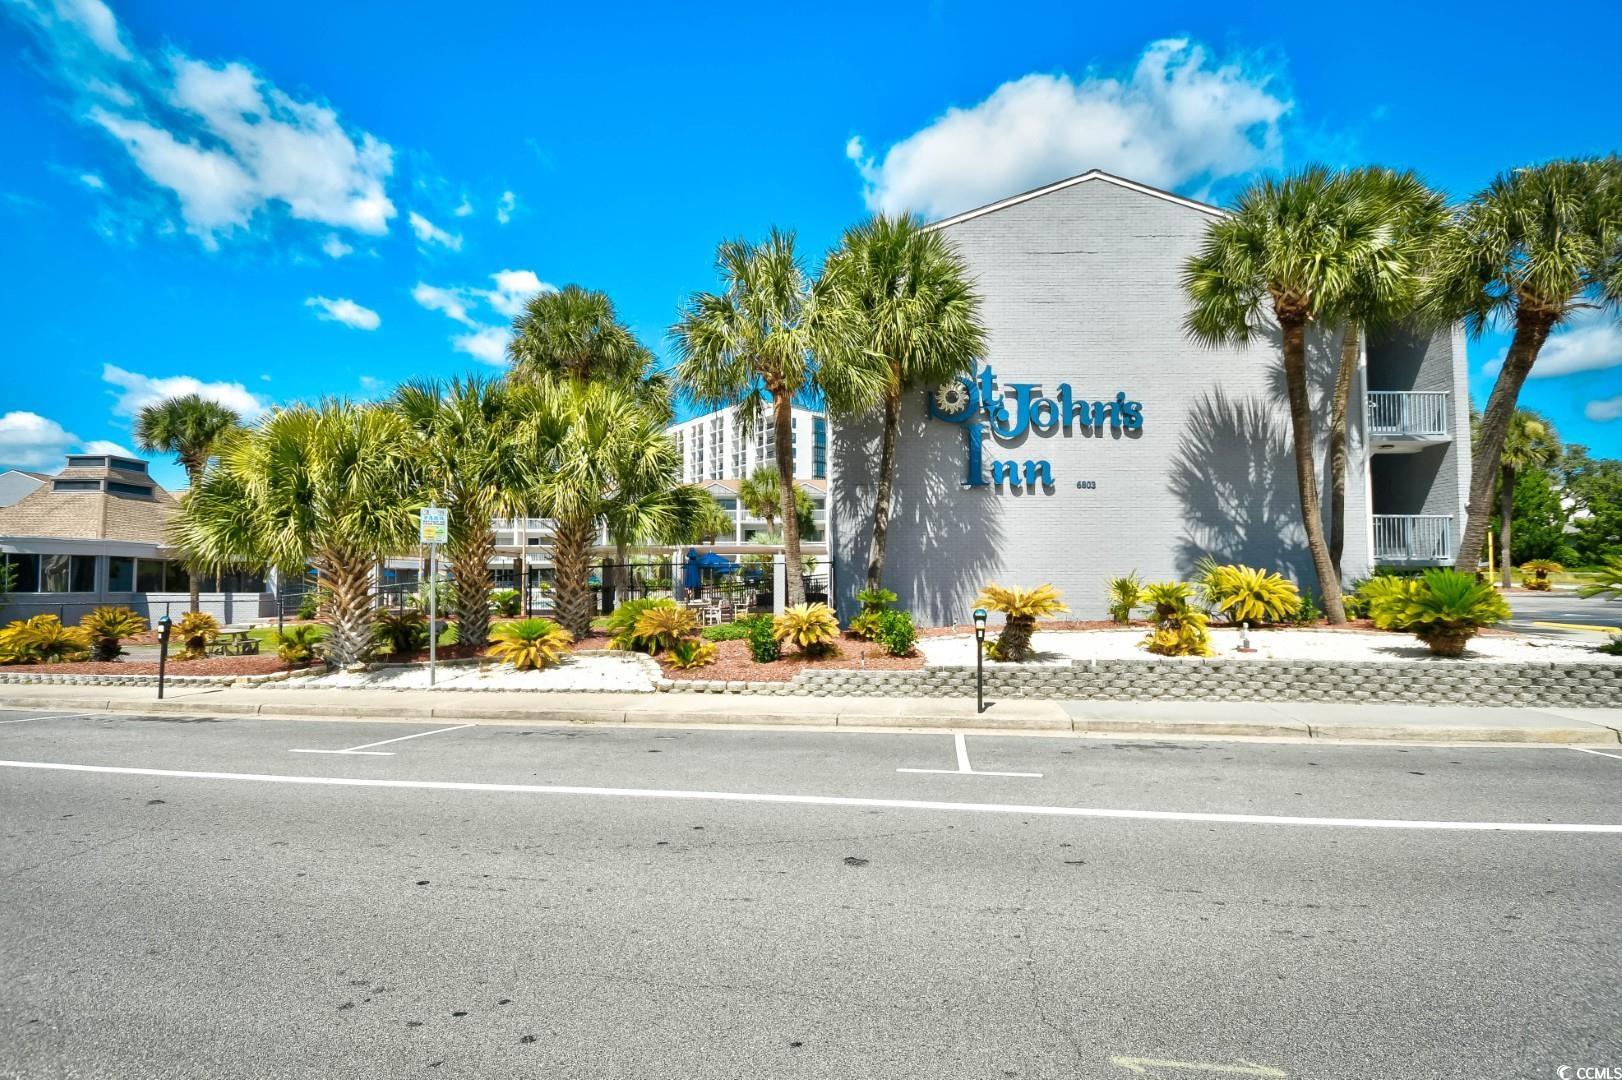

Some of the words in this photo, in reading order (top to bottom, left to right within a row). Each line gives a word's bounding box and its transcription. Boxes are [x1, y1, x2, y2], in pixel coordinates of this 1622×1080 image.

[984, 382, 1144, 439] John's
[961, 424, 1055, 486] Inn
[1076, 480, 1097, 490] 6803
